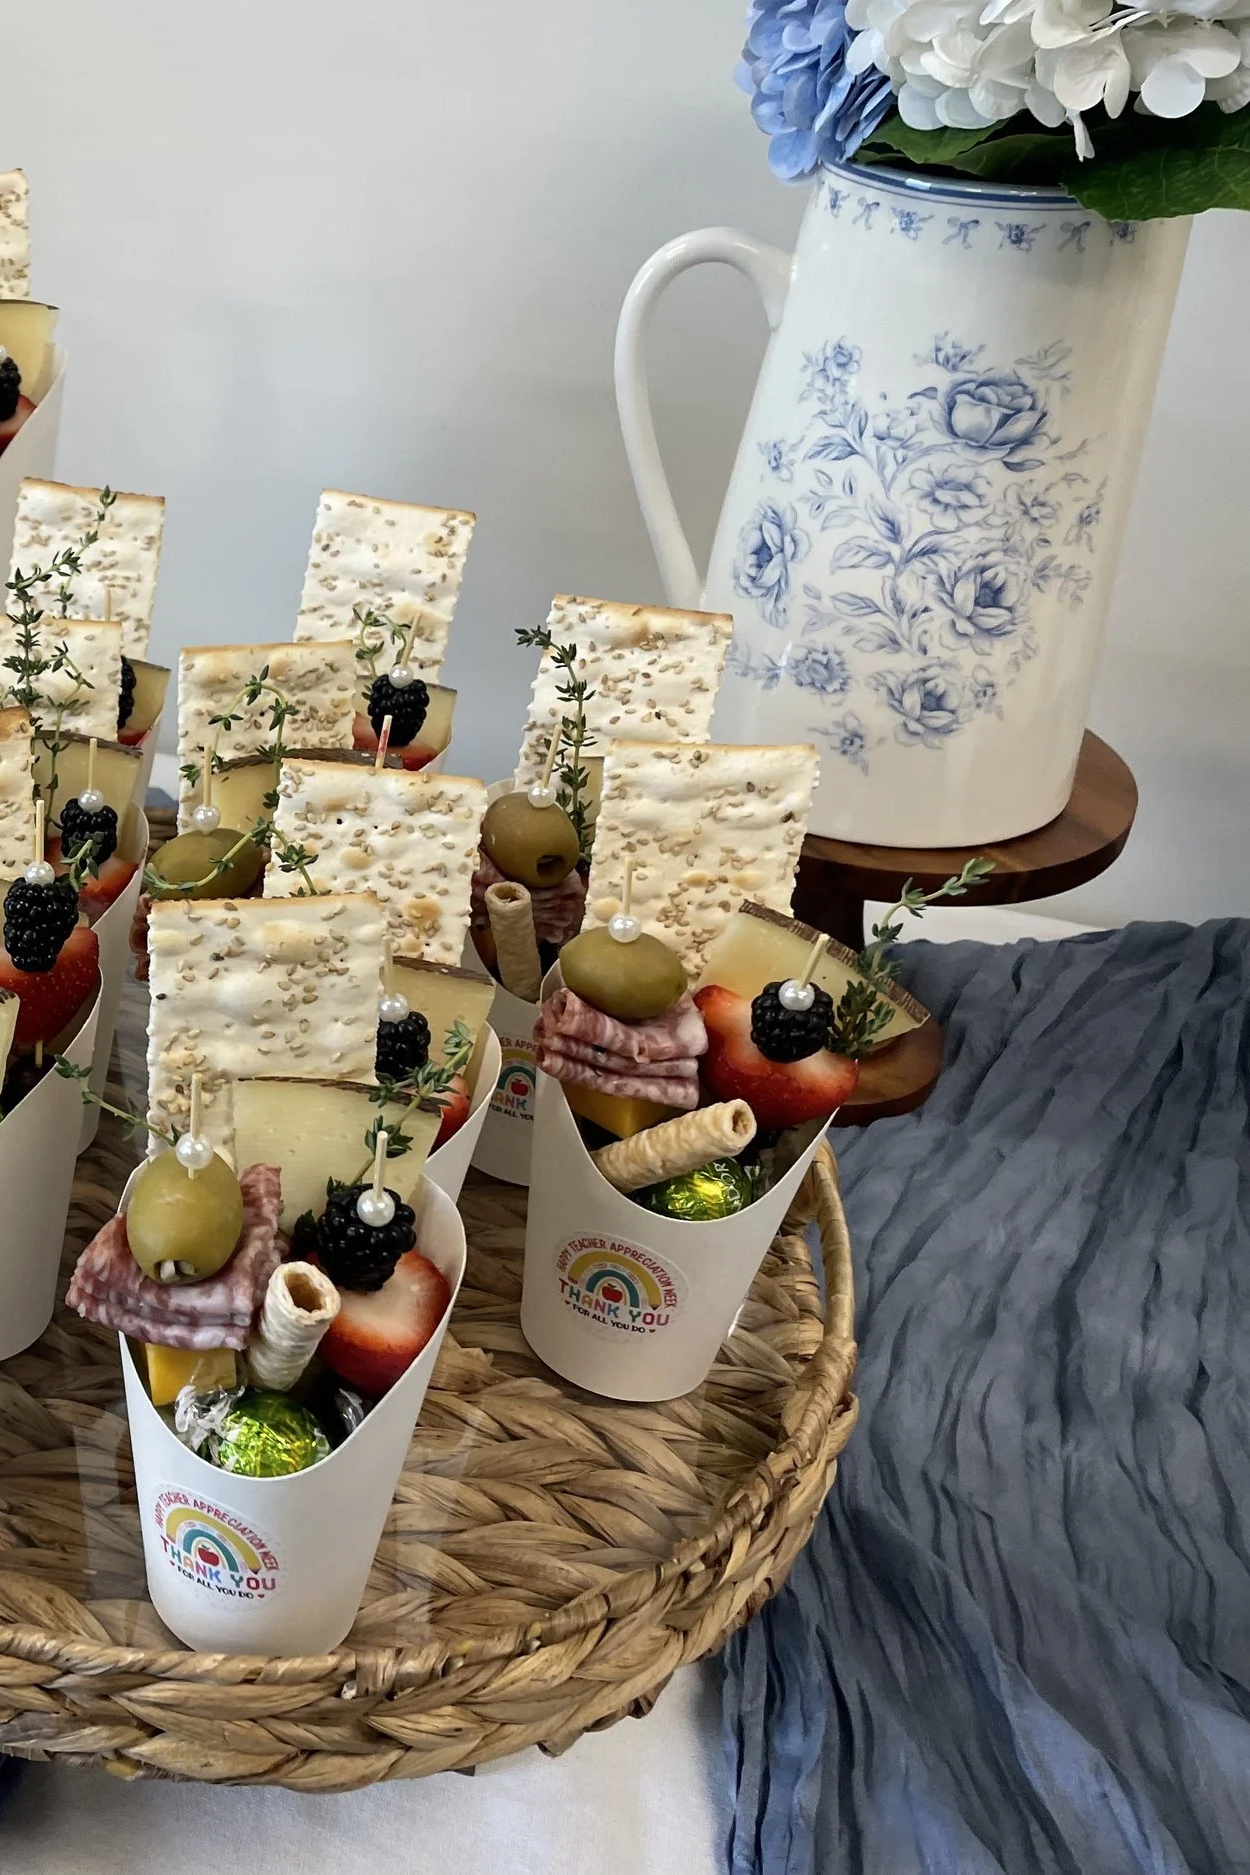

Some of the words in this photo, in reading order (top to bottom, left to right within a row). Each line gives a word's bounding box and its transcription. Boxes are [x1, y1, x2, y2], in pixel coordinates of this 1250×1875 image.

[568, 1238, 607, 1253] TEACHER
[610, 1242, 673, 1288] APPRECIATION
[664, 1287, 677, 1309] WEEK
[559, 1278, 620, 1318] THANK
[629, 1309, 669, 1326] YOU
[573, 1303, 590, 1317] FOR
[592, 1314, 608, 1325] ALL
[610, 1320, 630, 1331] YOU
[631, 1325, 646, 1334] DO
[193, 1499, 268, 1551] APPRECIATION
[161, 1535, 222, 1584] THANK
[230, 1573, 276, 1591] YOU
[177, 1566, 194, 1581] FOR
[197, 1578, 214, 1590] ALL
[215, 1585, 237, 1597] YOU
[238, 1591, 254, 1599] DO
